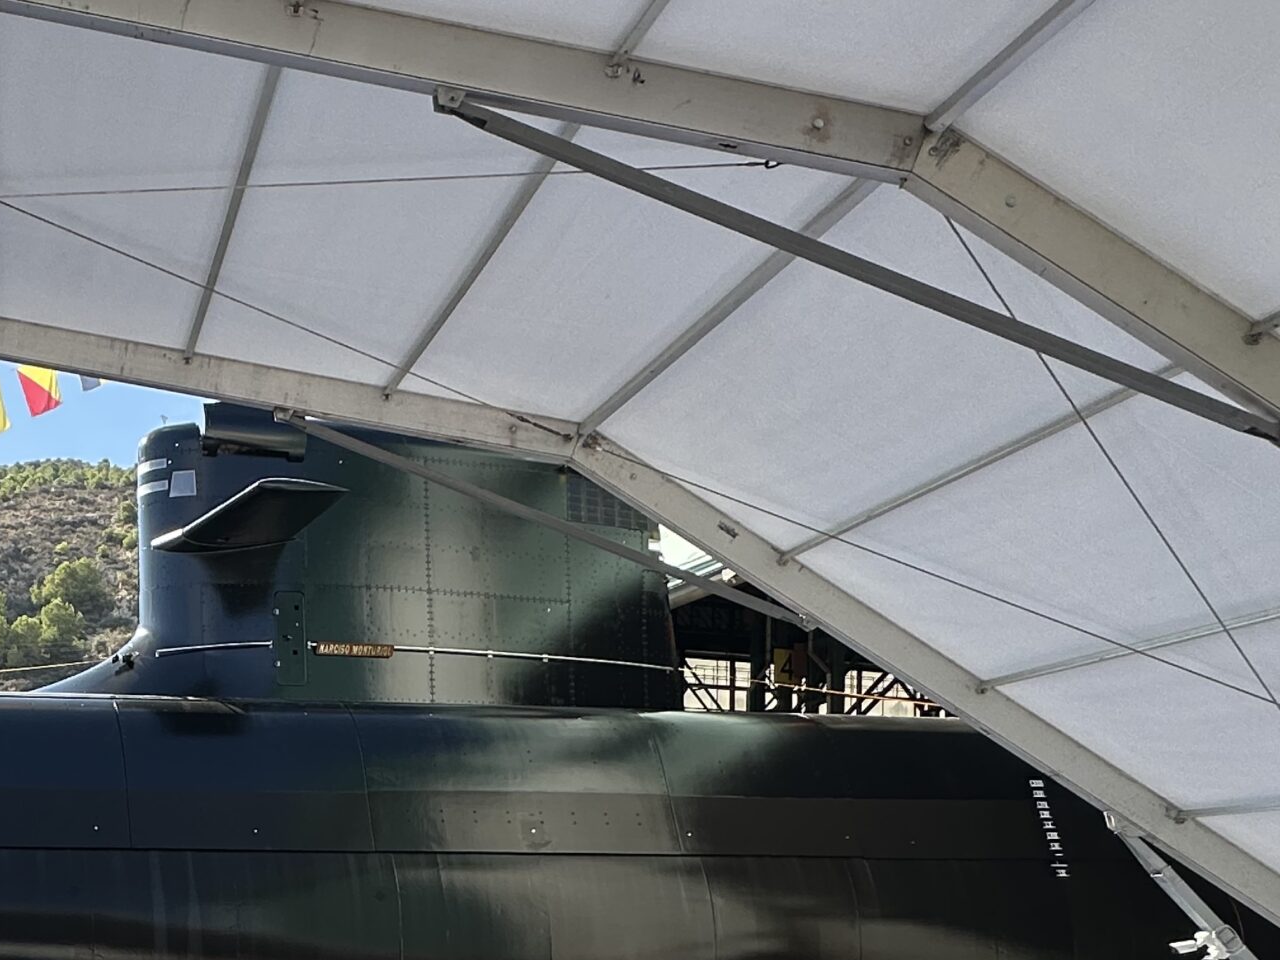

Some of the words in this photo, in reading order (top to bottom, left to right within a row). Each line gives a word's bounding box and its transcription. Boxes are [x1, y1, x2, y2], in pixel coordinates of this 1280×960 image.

[320, 644, 350, 654] NARCISO
[352, 645, 391, 656] MONTURIOL
[780, 651, 793, 681] 4
